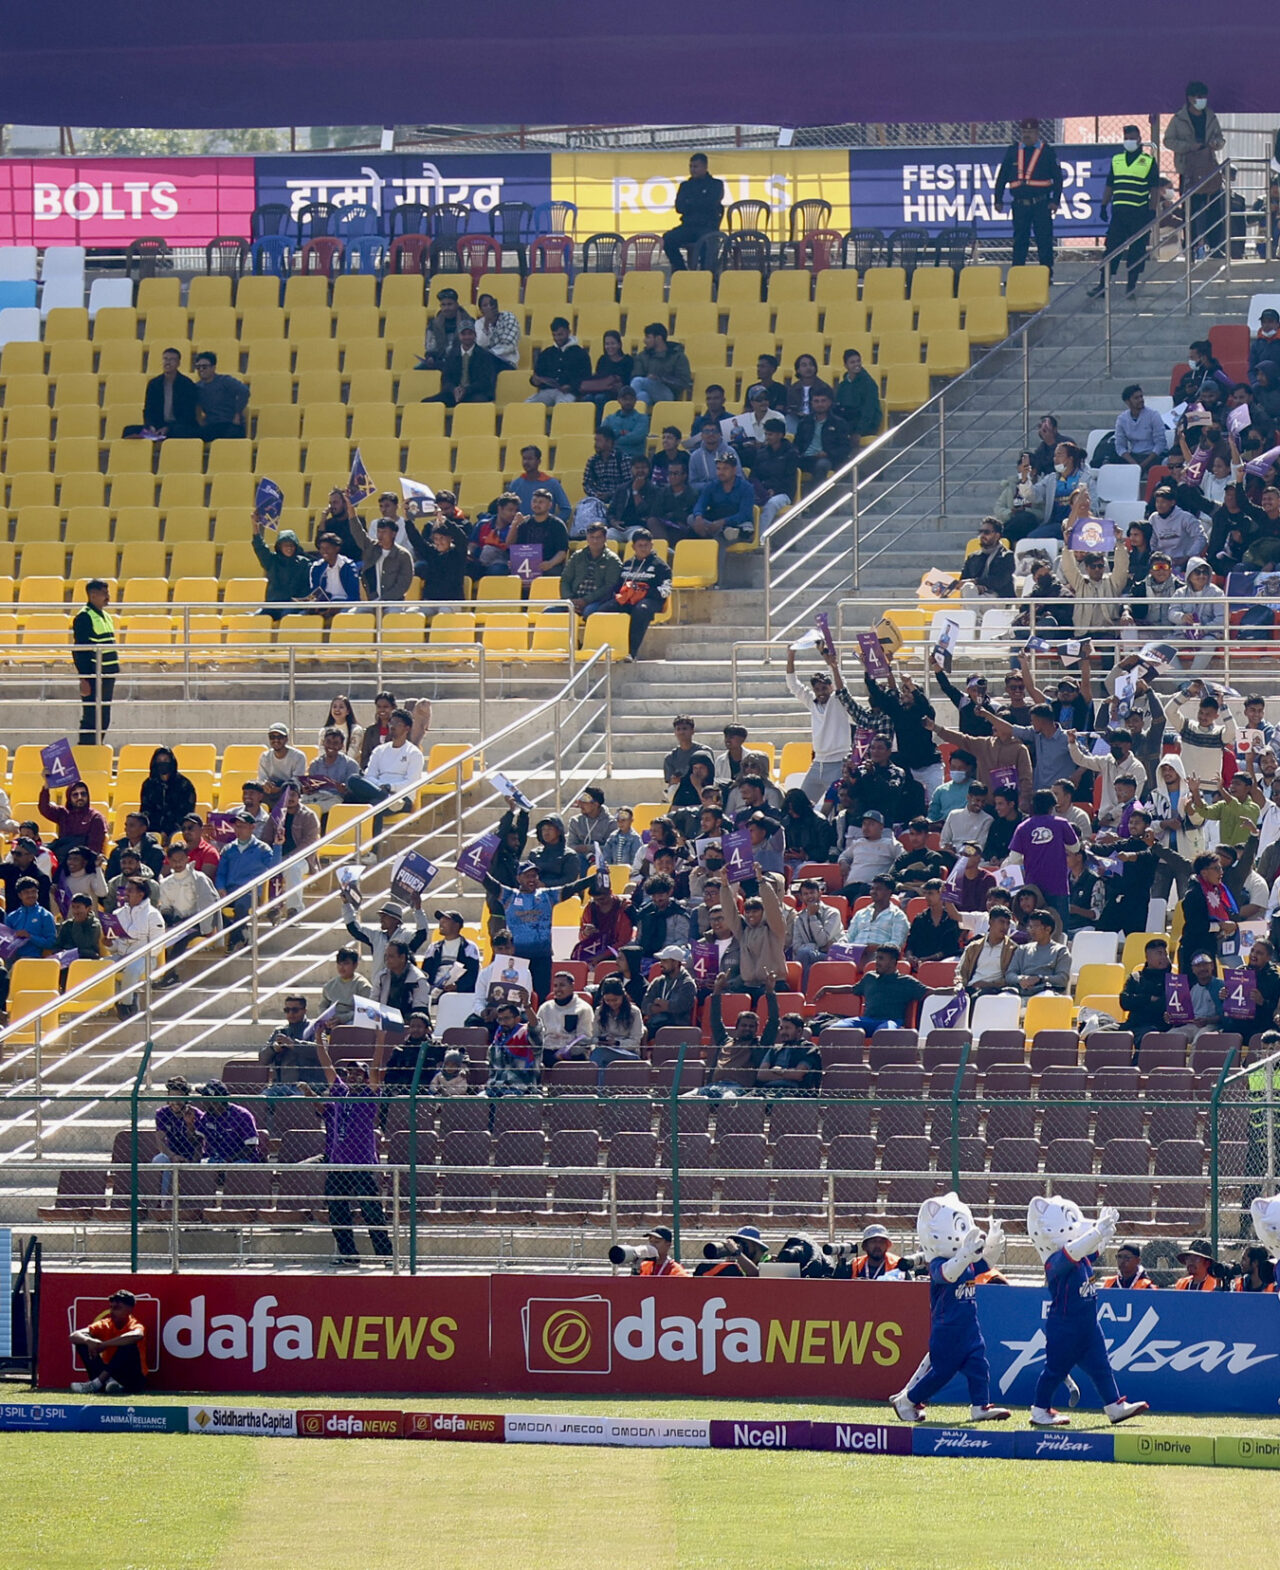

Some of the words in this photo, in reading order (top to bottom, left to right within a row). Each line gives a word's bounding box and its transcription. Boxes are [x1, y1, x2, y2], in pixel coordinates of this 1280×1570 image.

[903, 163, 1011, 190] FESTIV
[33, 181, 179, 221] BOLTS
[903, 192, 1093, 222] HIMALAS
[517, 558, 532, 578] 4
[51, 757, 65, 777] 4
[467, 846, 482, 866] 4
[730, 848, 743, 868] 4
[694, 958, 707, 978] 4
[5, 1407, 27, 1418] SPIL
[45, 1408, 68, 1419] SPIL
[100, 1414, 130, 1424] SANIMA
[132, 1415, 167, 1426] RELIANCE
[212, 1409, 261, 1428] Siddhartha
[262, 1411, 293, 1432] Capital
[508, 1421, 551, 1432] OMODA
[559, 1423, 604, 1435] JAECOO
[611, 1426, 654, 1437] OMODA
[662, 1428, 707, 1438] JAECOO
[733, 1423, 787, 1447] Ncell
[835, 1425, 888, 1450] Ncell
[933, 1433, 993, 1452] pulsar
[1035, 1435, 1094, 1455] pulsar
[1154, 1440, 1192, 1454] inDrive
